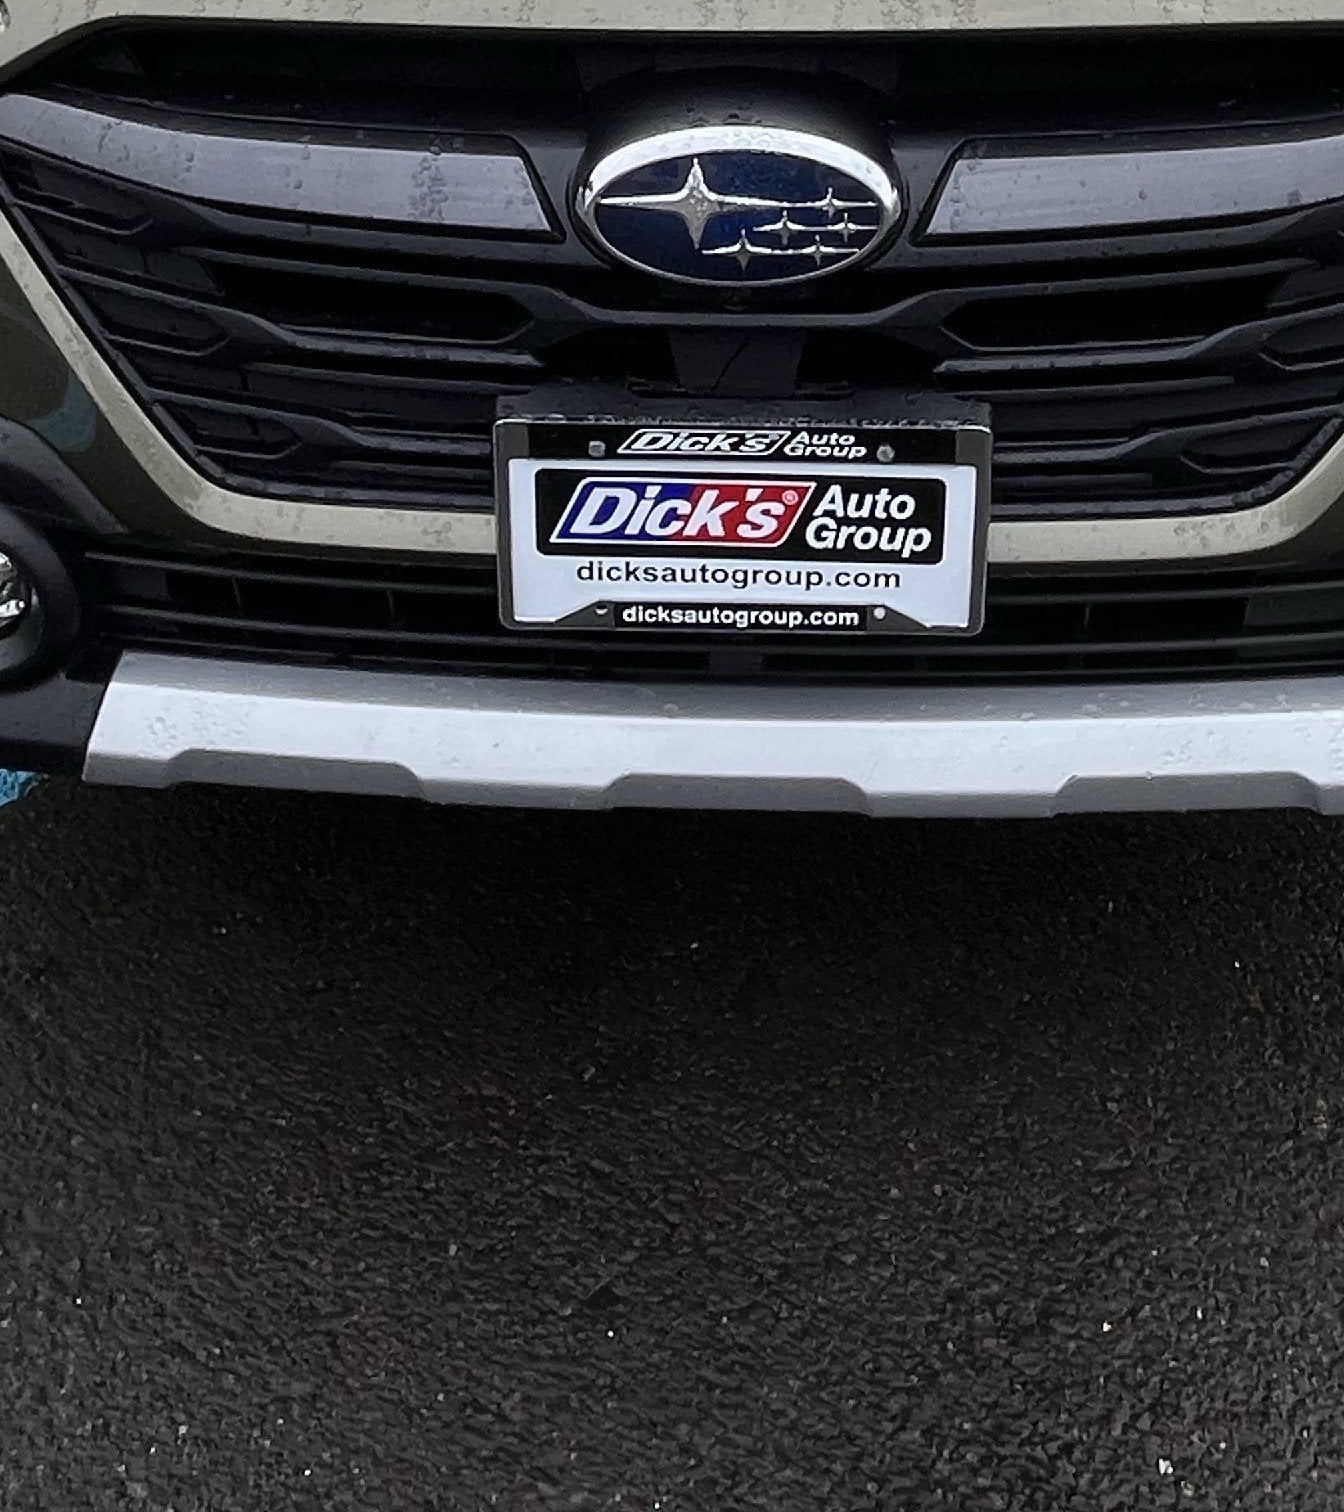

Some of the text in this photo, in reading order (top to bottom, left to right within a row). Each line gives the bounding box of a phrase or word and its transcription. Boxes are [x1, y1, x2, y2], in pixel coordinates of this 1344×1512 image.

[783, 443, 867, 459] Group
[790, 431, 856, 446] Auto
[813, 485, 916, 520] Auto
[805, 518, 932, 557] Group
[576, 560, 901, 591] dicksautogroup.com
[622, 605, 859, 629] dicksautogroup.com
